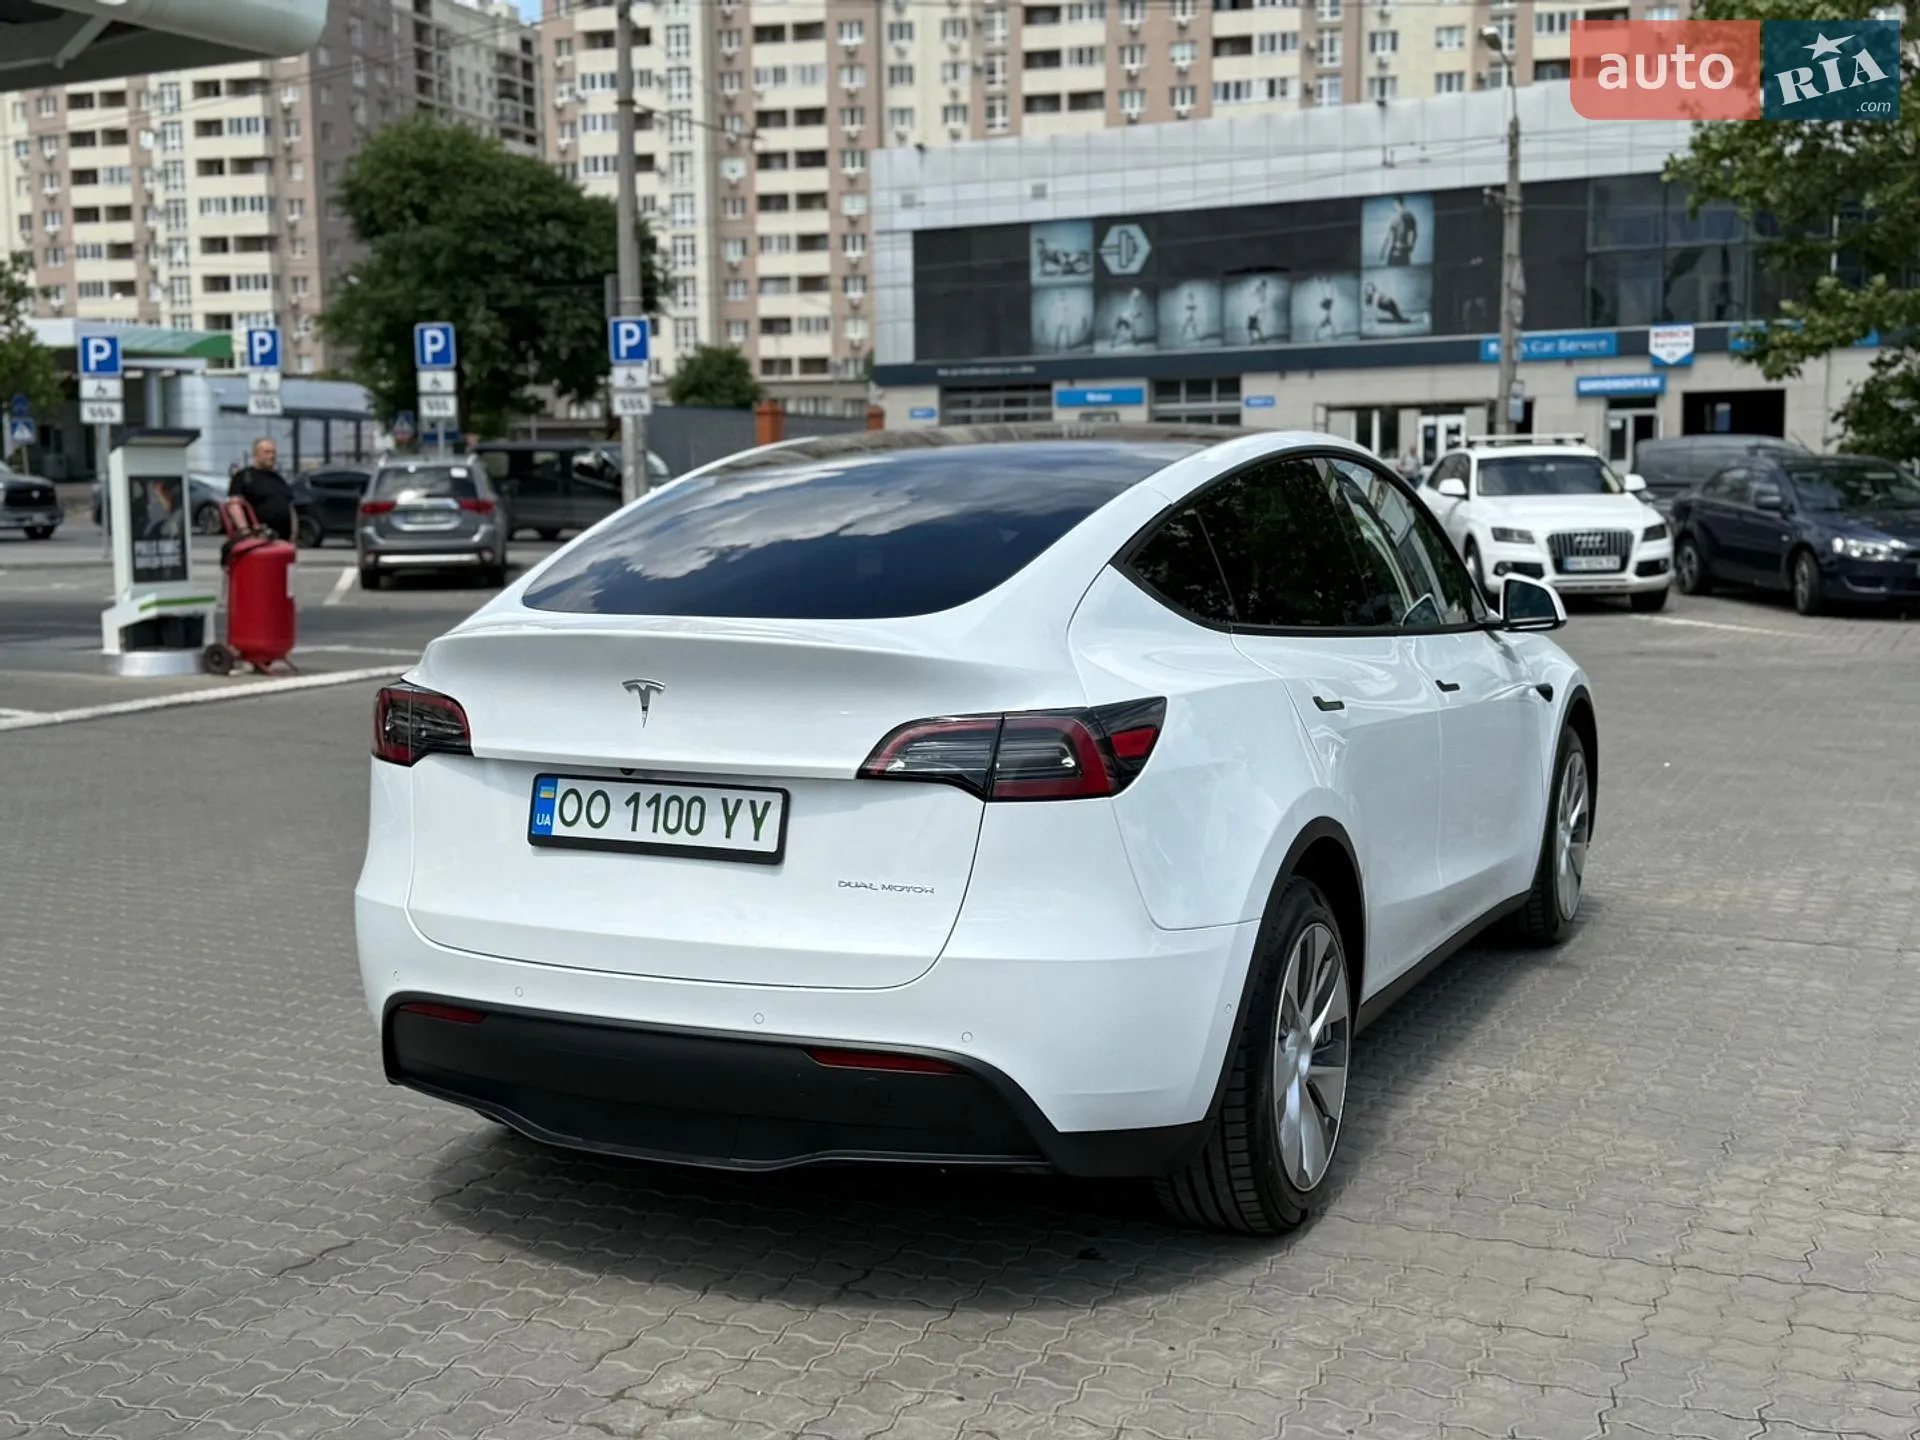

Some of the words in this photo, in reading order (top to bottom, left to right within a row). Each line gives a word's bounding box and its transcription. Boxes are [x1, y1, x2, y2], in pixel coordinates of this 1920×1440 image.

[87, 338, 112, 371] P
[251, 330, 273, 366] P
[424, 328, 446, 364] P
[618, 322, 642, 358] P
[536, 813, 552, 827] UA
[558, 787, 611, 829] OO
[624, 791, 707, 837] 1100
[721, 797, 772, 842] YY
[838, 880, 878, 891] DUAL
[881, 883, 934, 894] MOTOR
